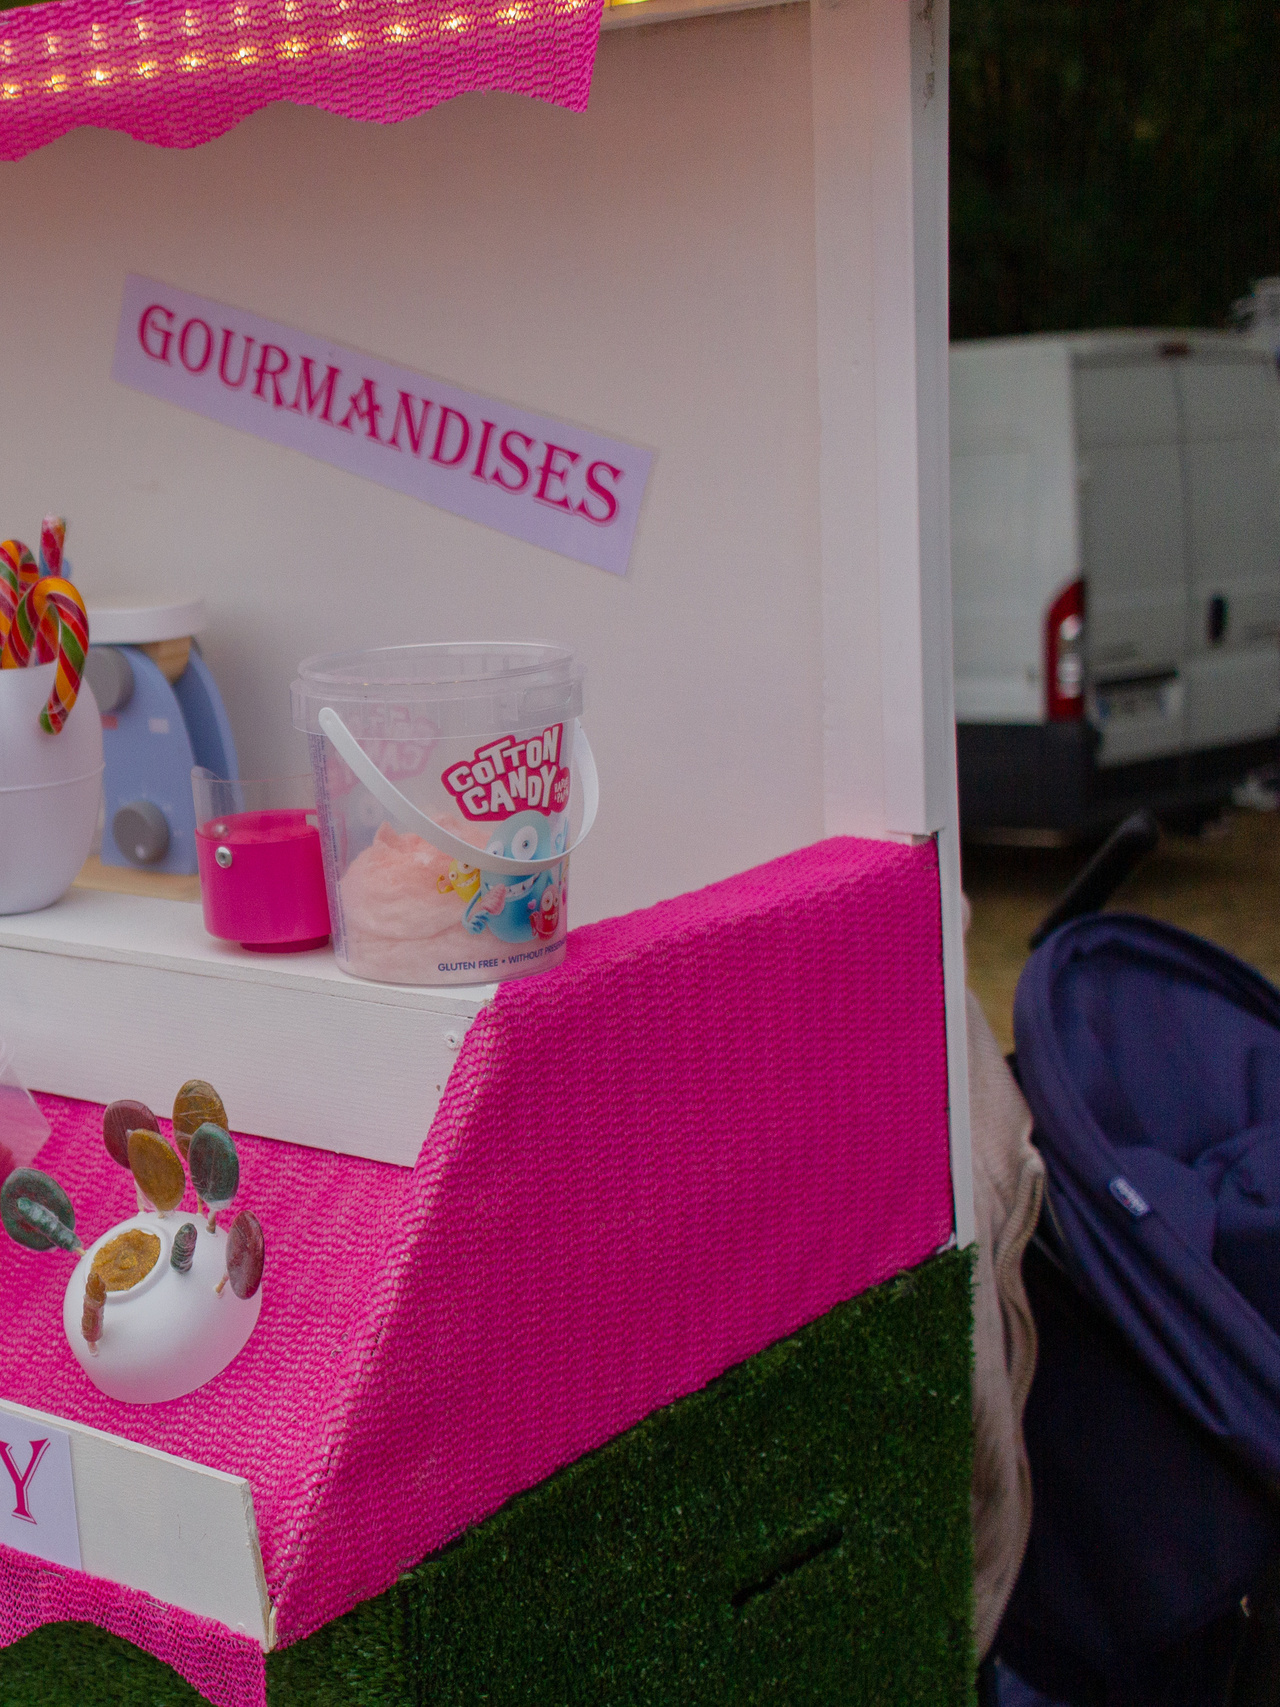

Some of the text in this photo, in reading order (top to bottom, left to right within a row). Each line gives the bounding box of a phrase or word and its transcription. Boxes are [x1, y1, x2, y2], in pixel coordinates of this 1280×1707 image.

[136, 303, 625, 527] GOURMANDISES
[447, 725, 560, 792] COTTON
[461, 765, 558, 816] CANDY
[438, 961, 476, 972] GLUTEN
[478, 959, 499, 968] FREE
[508, 948, 544, 964] WITHOUT
